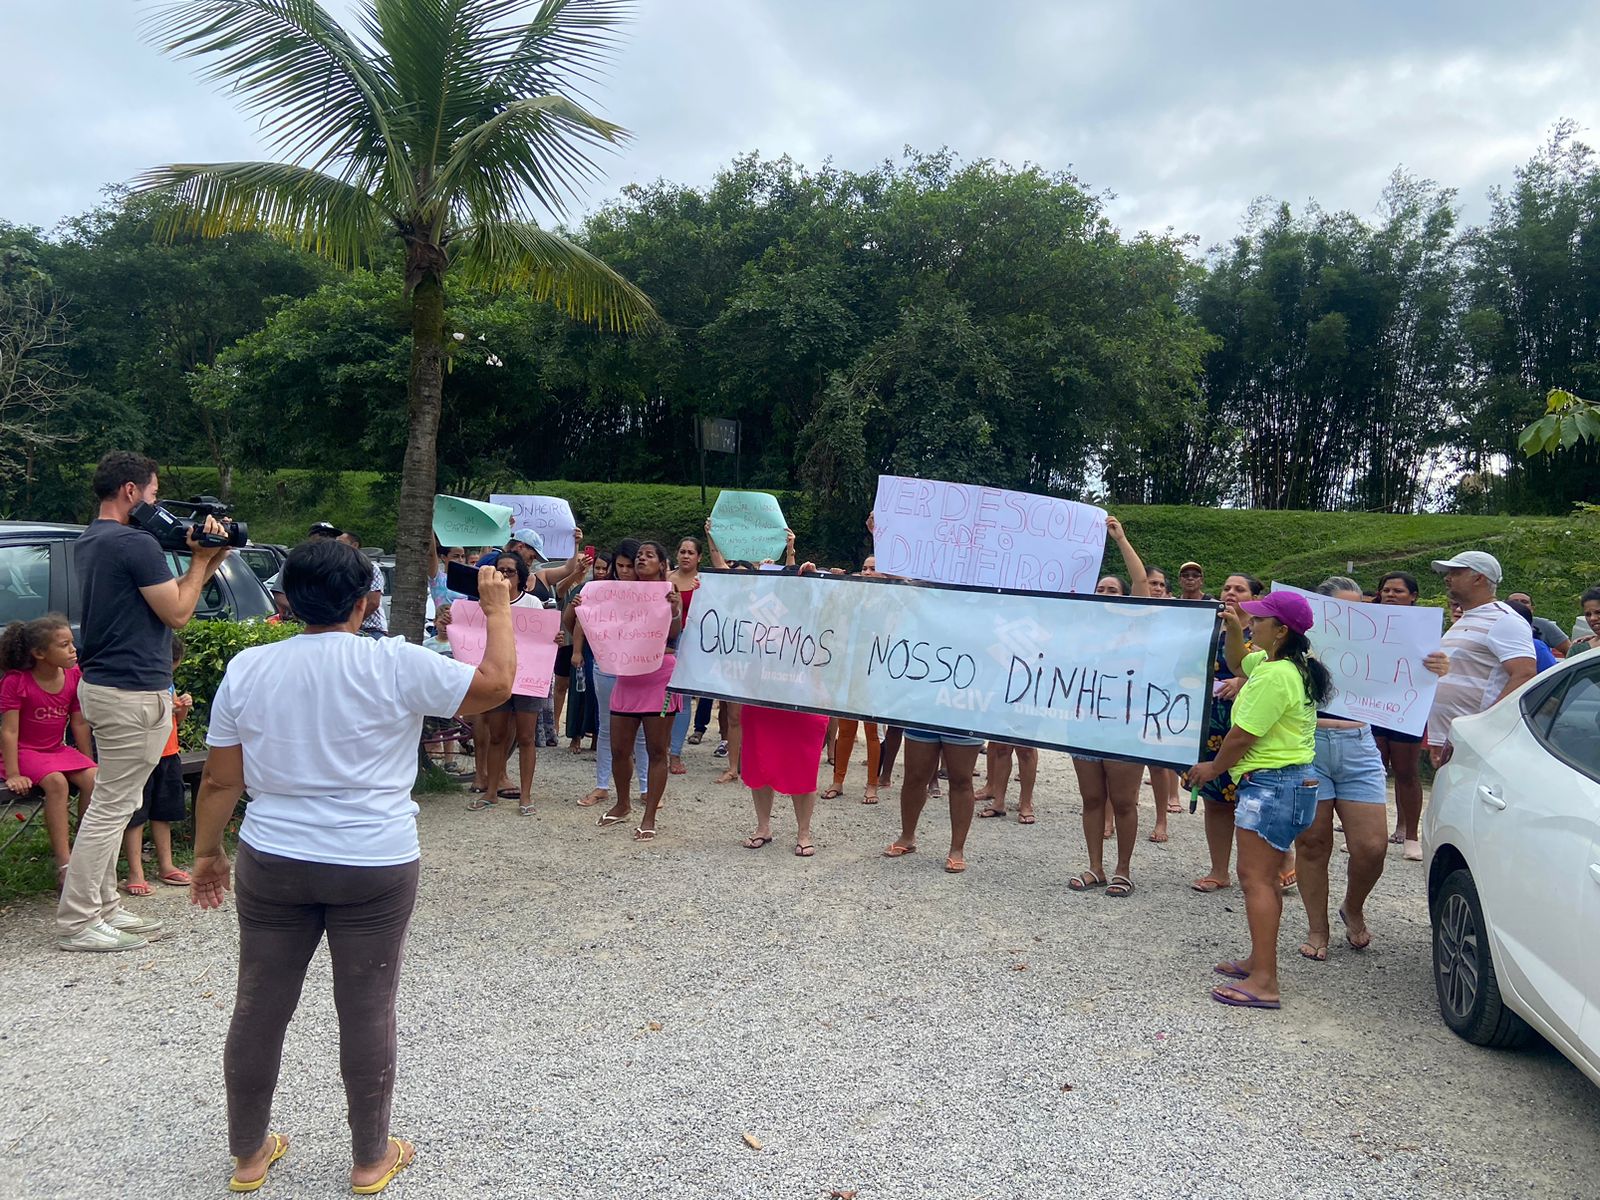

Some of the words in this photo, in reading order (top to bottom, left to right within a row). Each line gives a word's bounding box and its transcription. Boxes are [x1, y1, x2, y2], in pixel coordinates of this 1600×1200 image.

[535, 518, 556, 529] DO
[996, 533, 1013, 551] O
[582, 607, 618, 624] VILA
[700, 608, 835, 668] QUEREMOS
[867, 633, 977, 690] NOSSO
